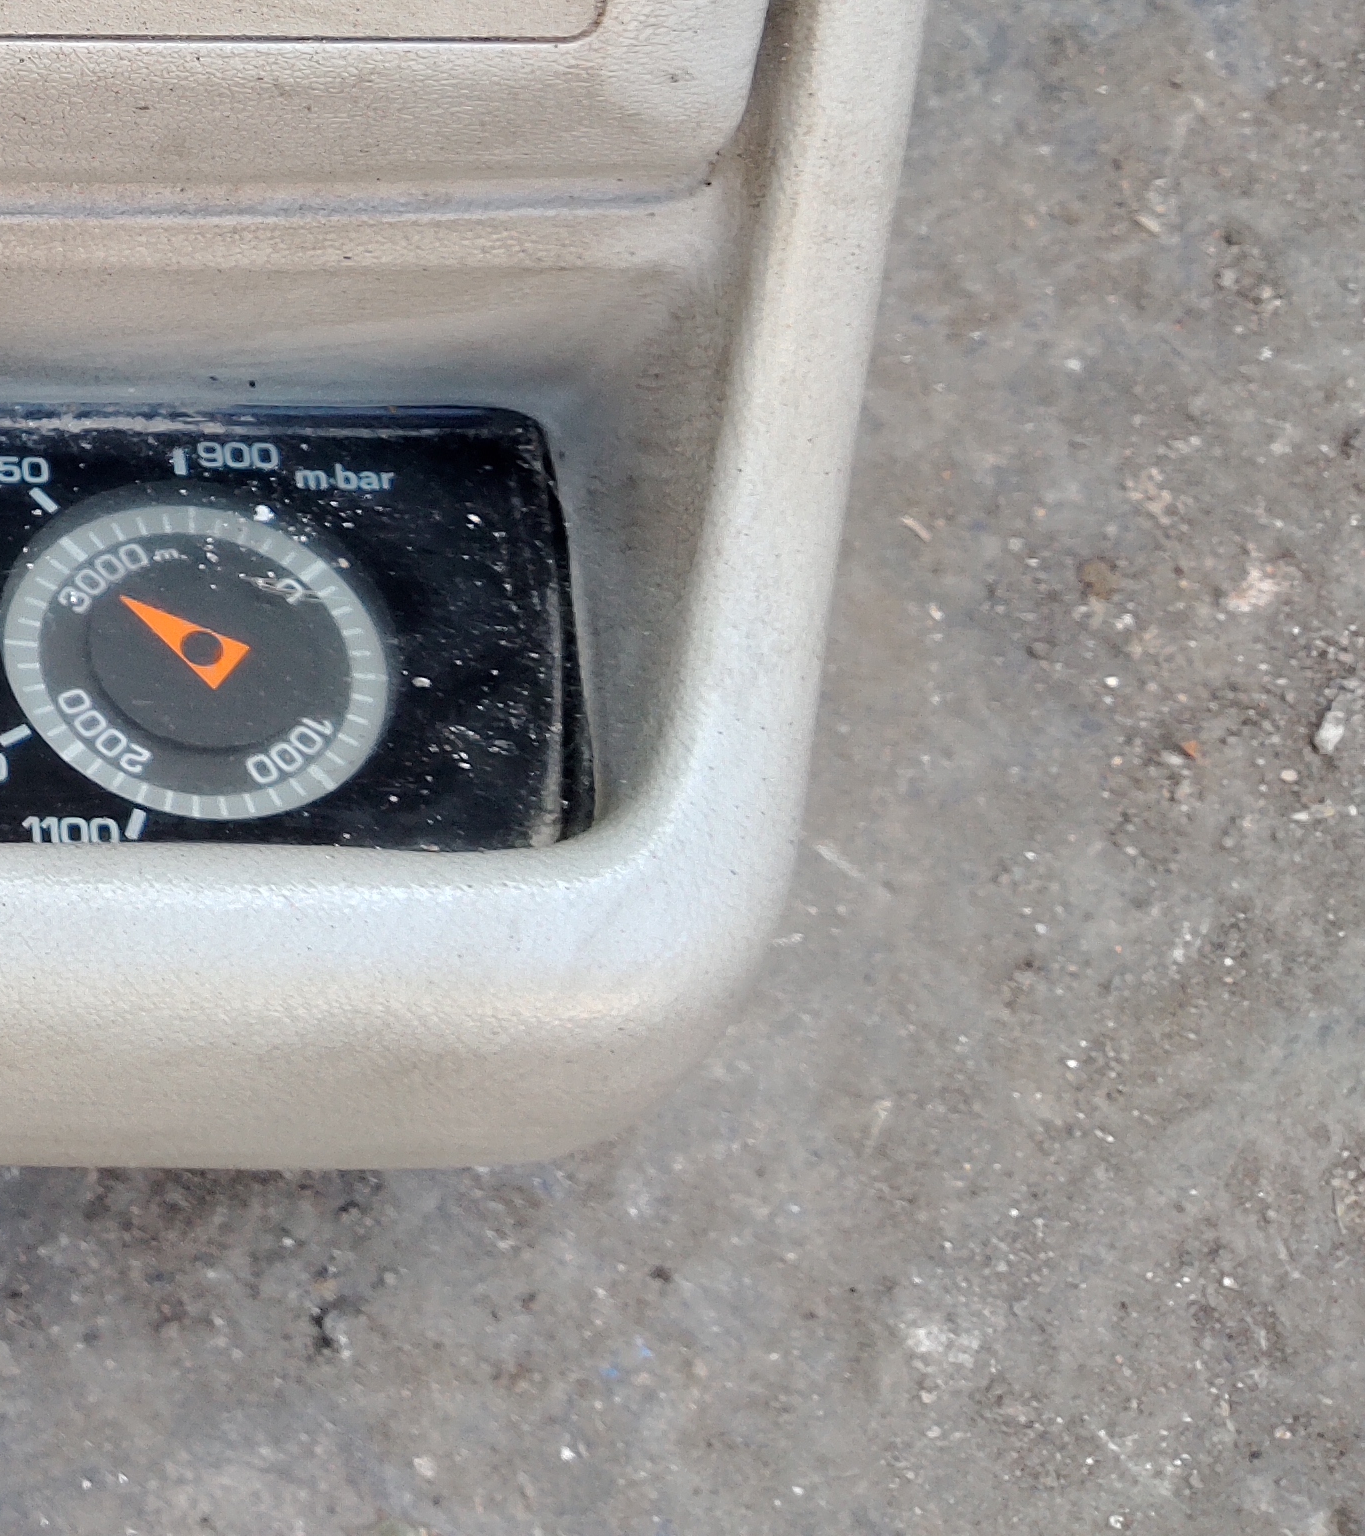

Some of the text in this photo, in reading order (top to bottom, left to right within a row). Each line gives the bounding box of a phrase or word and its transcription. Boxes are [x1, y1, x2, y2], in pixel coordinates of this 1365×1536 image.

[197, 441, 279, 470] 900
[57, 543, 150, 615] 3000
[57, 688, 153, 775] 2000
[245, 717, 335, 785] 1000
[22, 815, 119, 844] 1100
